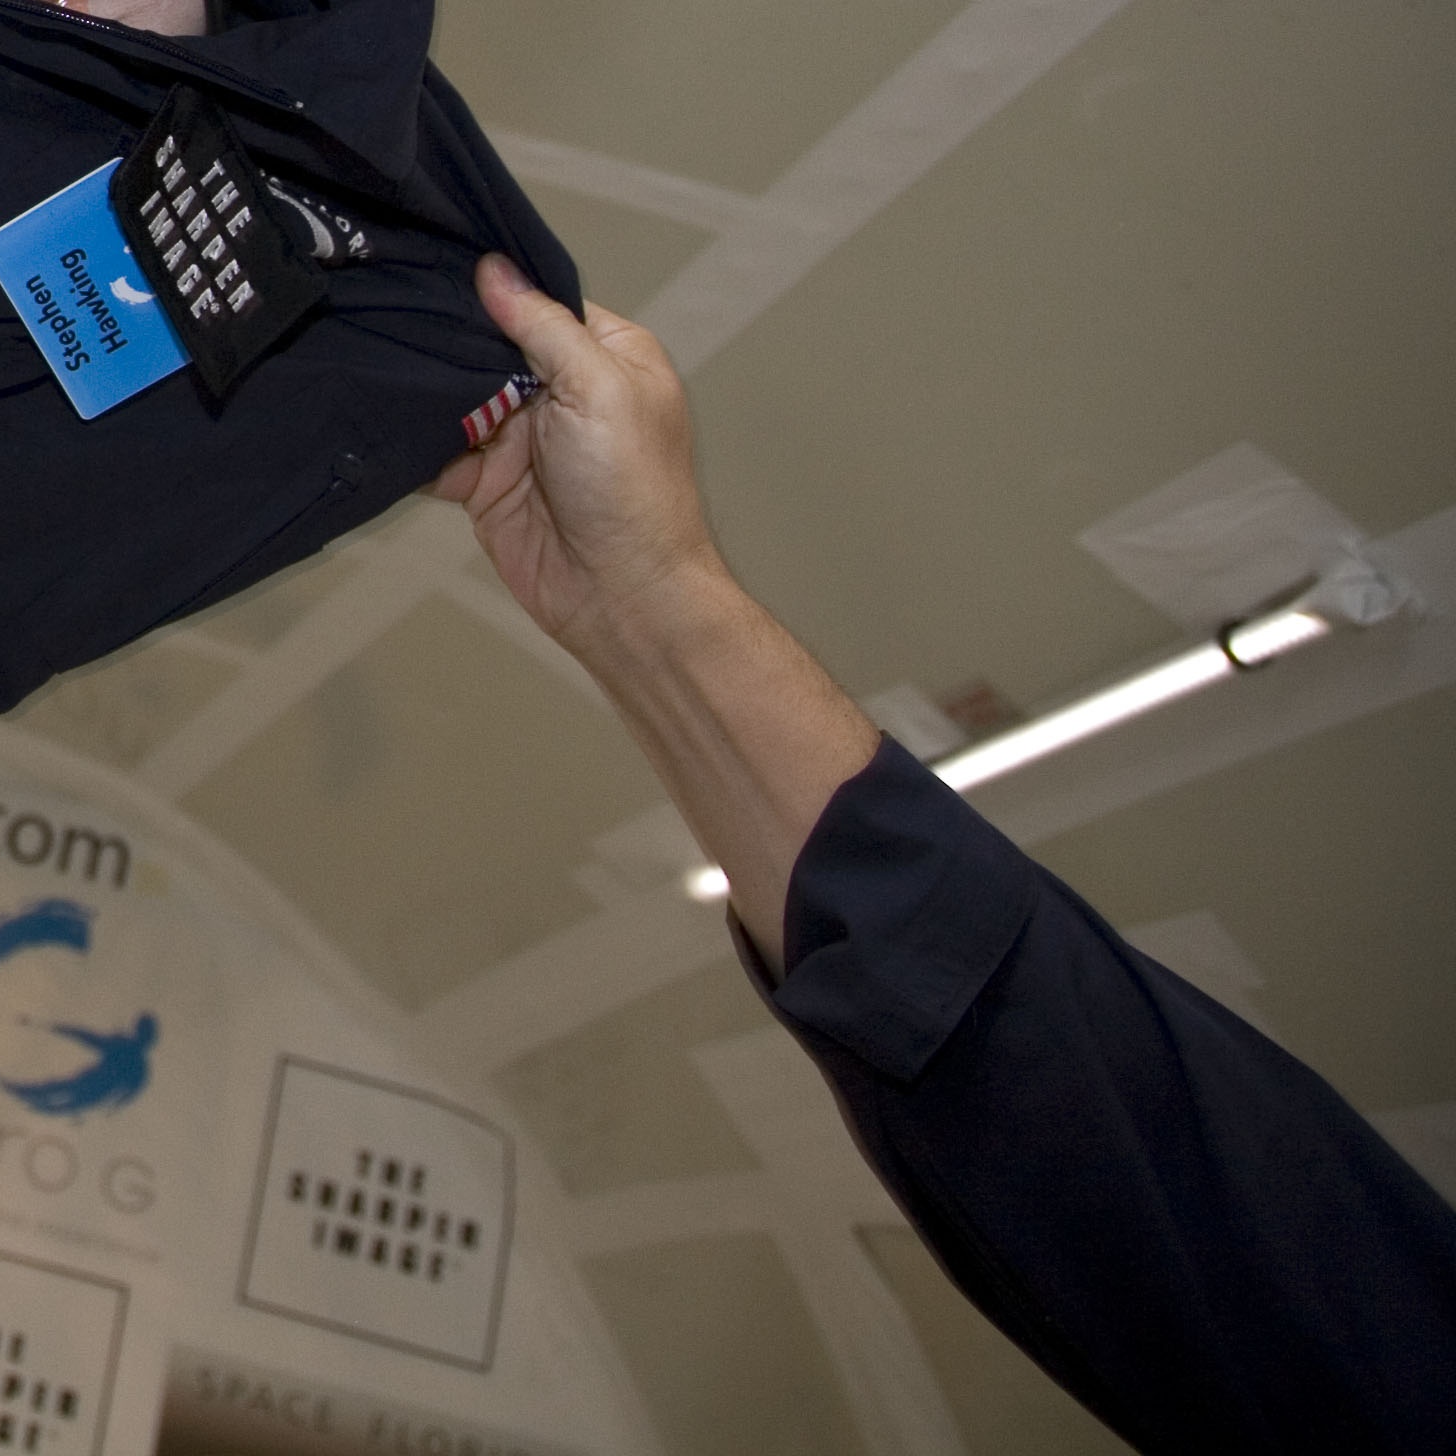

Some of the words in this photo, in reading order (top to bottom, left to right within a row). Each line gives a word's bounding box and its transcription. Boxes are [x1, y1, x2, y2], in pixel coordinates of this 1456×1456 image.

[155, 135, 255, 313] SHARPER
[200, 158, 253, 237] THE
[26, 274, 90, 371] Stephen
[60, 248, 128, 354] Hawking
[99, 1154, 158, 1215] G
[289, 1170, 479, 1249] SHARPER
[355, 1149, 426, 1195] THE
[311, 1218, 445, 1284] IMAGE
[195, 1365, 334, 1433] SPACE
